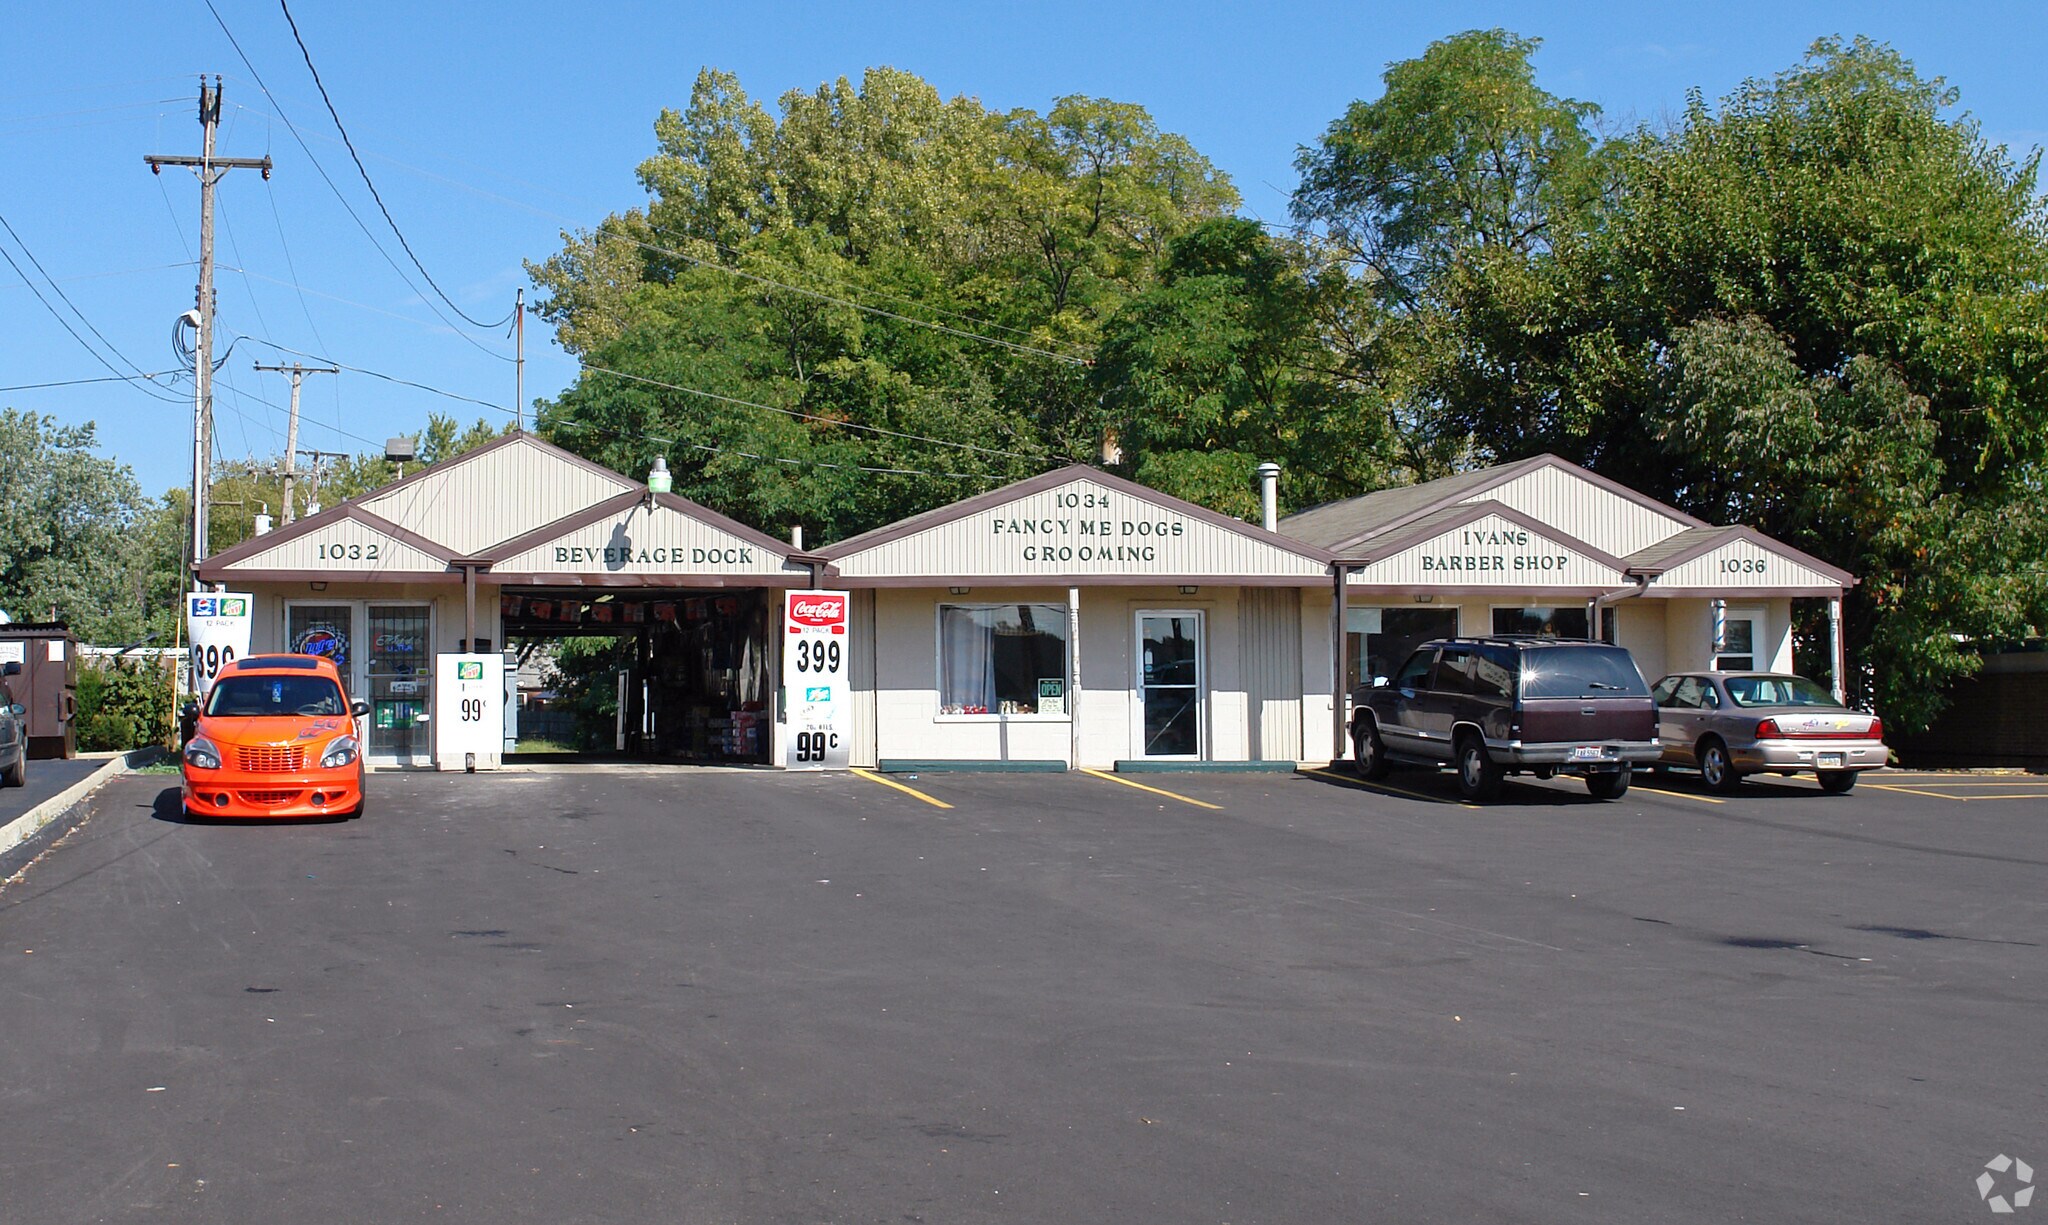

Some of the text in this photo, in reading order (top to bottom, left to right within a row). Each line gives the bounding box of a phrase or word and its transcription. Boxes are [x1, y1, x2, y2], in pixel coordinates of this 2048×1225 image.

[1057, 493, 1109, 509] 1034
[993, 519, 1184, 537] FANCY ME DOGS
[1463, 531, 1527, 547] IVANS
[319, 543, 379, 560] 1032
[555, 547, 753, 564] BEVERAGE DOCK
[1023, 546, 1156, 562] GROOMING
[1422, 555, 1568, 571] BARBER SHOP
[1720, 558, 1766, 574] 1036
[797, 639, 841, 674] 399
[1041, 683, 1062, 696] OPEN
